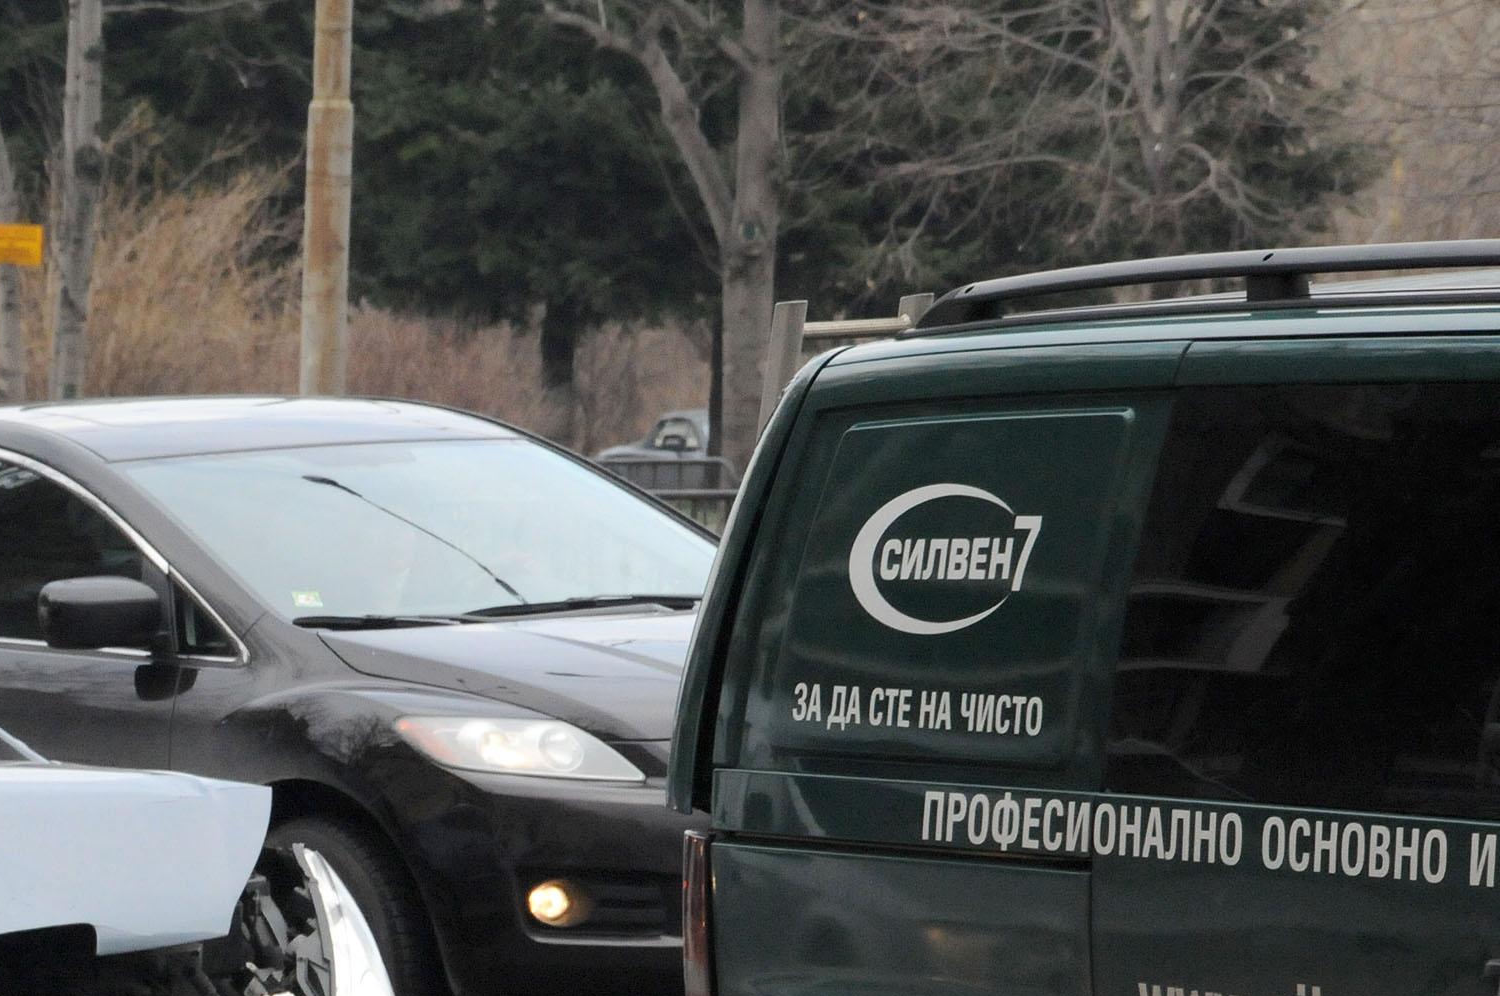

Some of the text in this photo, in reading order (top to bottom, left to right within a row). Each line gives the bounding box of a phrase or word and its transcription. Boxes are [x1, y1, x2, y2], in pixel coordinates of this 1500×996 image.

[792, 682, 1043, 736] ЗА ДА СТЕ НА ЧИСТО
[921, 791, 1497, 887] ПРОФЕСИОНАЛНО ОСНОВНО И
